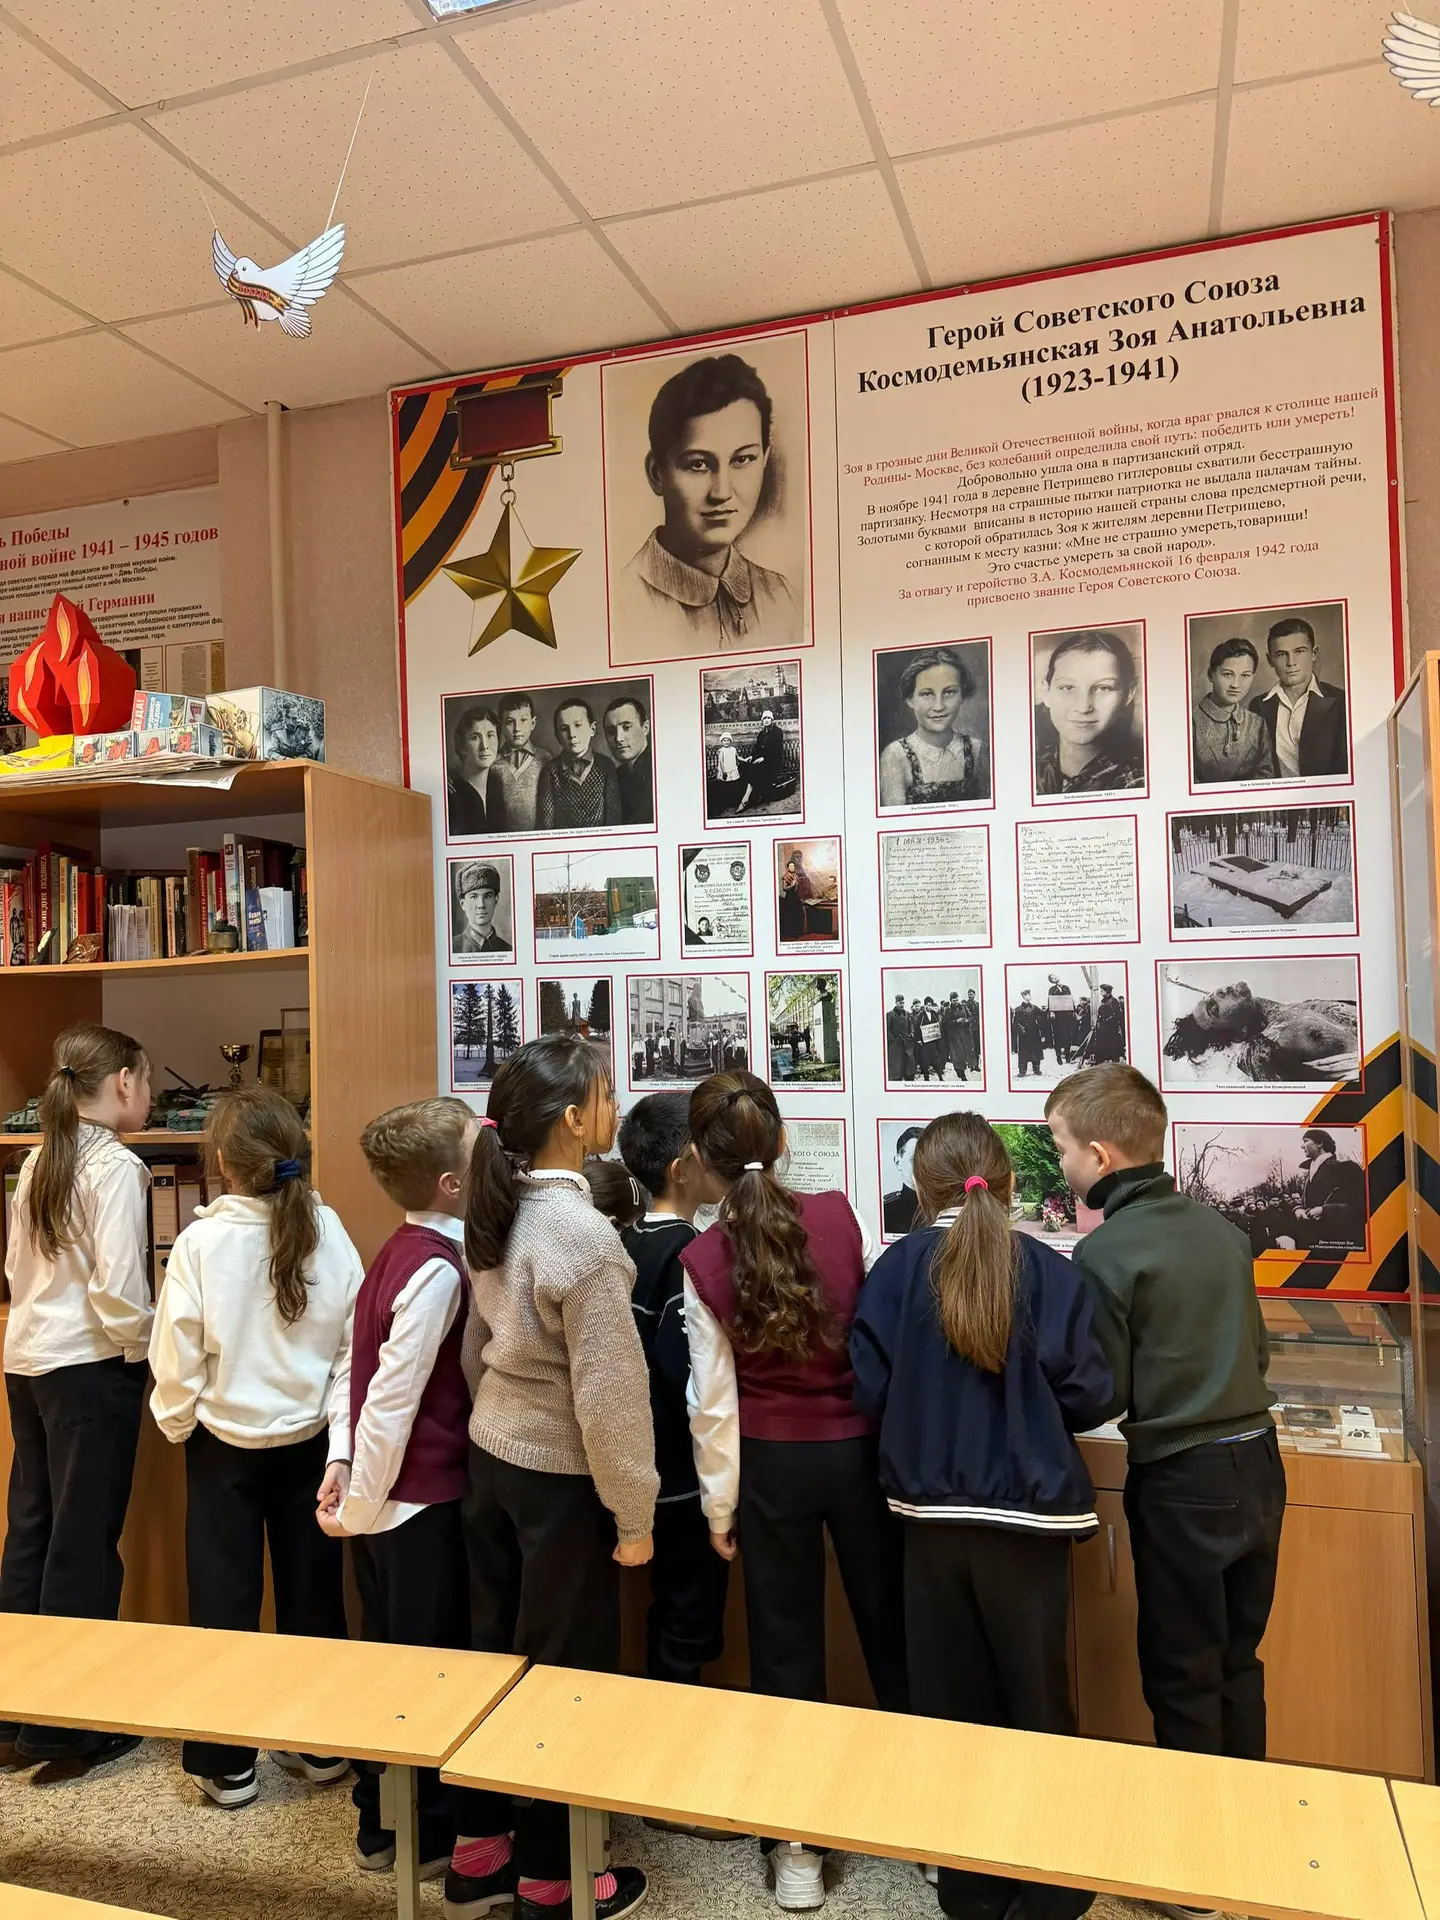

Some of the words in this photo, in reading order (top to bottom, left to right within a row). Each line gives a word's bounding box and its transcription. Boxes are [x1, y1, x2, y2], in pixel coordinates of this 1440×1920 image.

[926, 315, 1005, 350] Герой
[1013, 292, 1175, 334] Советского
[1184, 274, 1280, 304] Союза
[857, 338, 1100, 394] Космодемьянская
[1108, 328, 1157, 352] Зоя
[1166, 296, 1366, 343] Анатольевна
[1021, 354, 1179, 405] (1923-1941)
[844, 462, 863, 474] Зоя
[866, 462, 873, 471] в
[876, 455, 922, 471] грозные
[925, 452, 947, 464] дни
[950, 441, 998, 459] Великой
[1002, 427, 1095, 451] Отечественной
[1099, 423, 1143, 437] войны,
[1147, 418, 1181, 430] когда
[1184, 413, 1213, 426] враг
[1216, 406, 1260, 423] рвался
[1264, 405, 1272, 413] к
[1275, 396, 1330, 412] столице
[1334, 386, 1378, 403] нашей
[864, 472, 912, 486] Родины-
[915, 465, 963, 478] Москве,
[966, 459, 985, 471] без
[988, 448, 1051, 468] колебаний
[1055, 441, 1127, 459] определила
[1130, 433, 1160, 448] свой
[1164, 431, 1197, 445] путь:
[1201, 422, 1262, 438] победить
[1266, 418, 1290, 429] или
[1294, 406, 1355, 427] умереть!
[867, 502, 875, 514] В
[879, 498, 918, 513] ноябре
[923, 493, 947, 507] 1941
[953, 492, 978, 503] года
[981, 490, 988, 499] в
[991, 483, 1040, 499] деревне
[1043, 473, 1114, 491] Петрищево
[1117, 463, 1192, 480] гитлеровцы
[1196, 454, 1255, 470] схватили
[1259, 441, 1353, 461] бесстрашную
[957, 469, 1037, 487] Добровольно
[1040, 464, 1073, 478] ушла
[1076, 460, 1098, 471] она
[1102, 459, 1109, 467] в
[1112, 443, 1200, 466] партизанский
[1203, 441, 1245, 454] отряд.
[857, 530, 914, 545] Золотыми
[917, 523, 966, 539] буквами
[973, 516, 1025, 530] вписаны
[1029, 514, 1035, 523] в
[1039, 507, 1093, 522] историю
[1097, 498, 1137, 514] нашей
[1140, 495, 1187, 509] страны
[1190, 490, 1227, 502] слова
[1231, 474, 1326, 498] предсмертной
[1330, 473, 1366, 487] речи,
[860, 515, 927, 531] партизанку.
[930, 506, 987, 521] Несмотря
[991, 503, 1005, 513] на
[1008, 495, 1070, 511] страшные
[1074, 489, 1113, 502] пытки
[1117, 480, 1181, 496] патриотка
[1185, 477, 1200, 487] не
[1204, 471, 1251, 484] выдала
[1256, 463, 1310, 478] палачам
[1314, 456, 1362, 470] тайны.
[12, 527, 70, 546] Победы
[32, 548, 76, 566] войне
[81, 539, 114, 559] 1941
[134, 531, 169, 550] 1945
[174, 527, 218, 545] годов
[905, 553, 970, 568] согнанным
[974, 551, 981, 560] к
[984, 547, 1019, 559] месту
[1023, 542, 1061, 554] казни:
[1065, 536, 1100, 549] «Мне
[1104, 534, 1118, 544] не
[1122, 527, 1177, 542] страшно
[924, 543, 931, 551] с
[934, 533, 981, 550] которой
[984, 527, 1053, 544] обратилась
[1056, 523, 1077, 534] Зоя
[1081, 523, 1088, 531] к
[1091, 515, 1147, 530] жителям
[1150, 508, 1203, 524] деревни
[1206, 499, 1286, 515] Петрищево,
[110, 561, 131, 569] Второй
[132, 557, 157, 566] мировой
[898, 587, 912, 599] За
[914, 585, 953, 597] отвагу
[956, 584, 963, 592] и
[967, 576, 1027, 592] геройство
[1030, 570, 1055, 583] З.А.
[1059, 556, 1173, 580] Космодемьянской
[1179, 553, 1192, 566] 16
[1196, 550, 1250, 566] февраля
[1256, 542, 1286, 556] 1942
[1290, 541, 1319, 552] года
[987, 561, 1010, 573] Это
[1013, 557, 1059, 570] счастье
[1063, 550, 1113, 566] умереть
[1116, 548, 1129, 557] за
[1133, 541, 1162, 555] свой
[1166, 539, 1216, 552] народ».
[89, 594, 154, 613] Германии
[967, 591, 1030, 607] присвоено
[1033, 586, 1075, 598] звание
[1079, 581, 1113, 594] Героя
[1117, 572, 1190, 588] Советского
[1194, 567, 1241, 579] Союза.
